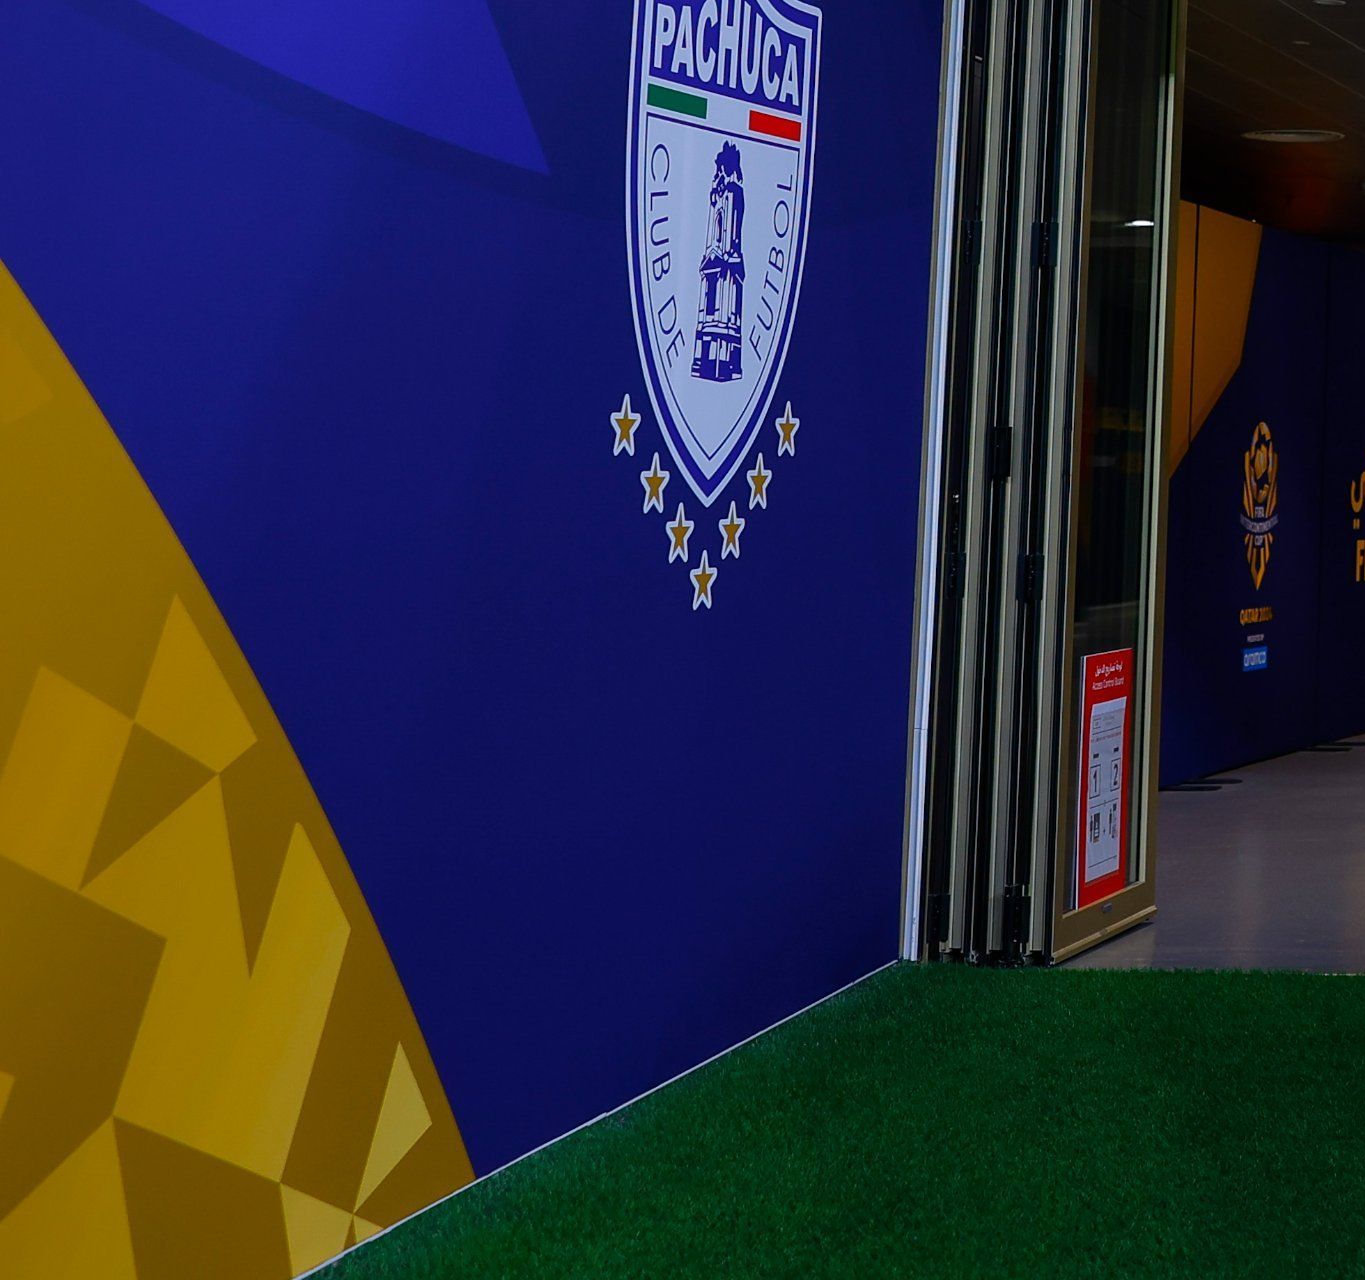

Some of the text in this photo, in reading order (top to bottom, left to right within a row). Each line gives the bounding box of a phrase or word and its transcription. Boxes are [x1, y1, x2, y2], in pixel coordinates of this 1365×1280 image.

[650, 143, 687, 371] CLUB DE
[749, 173, 794, 363] FUTBOL
[1093, 763, 1119, 793] 1 2
